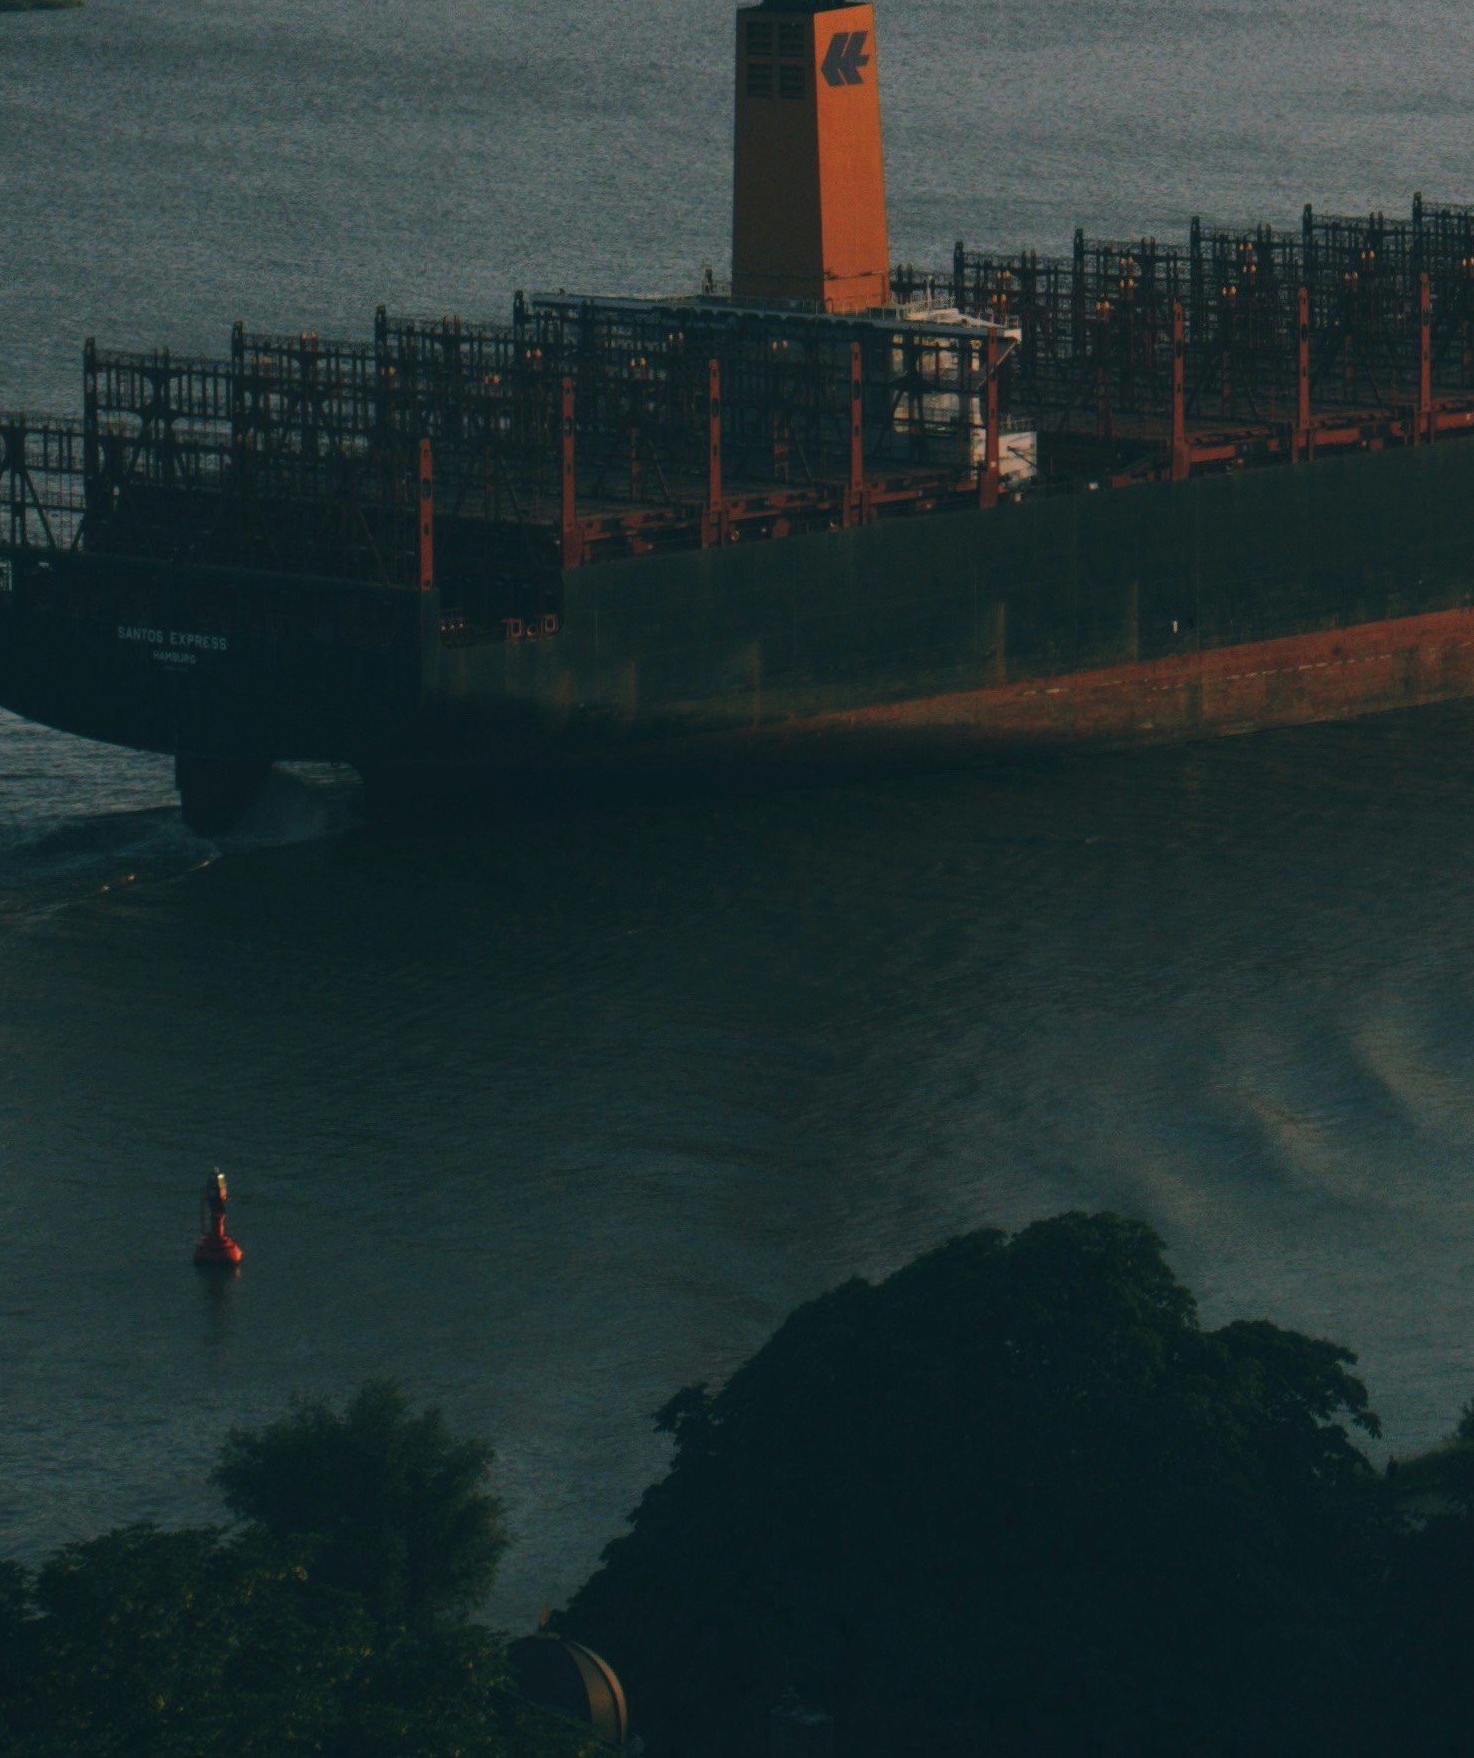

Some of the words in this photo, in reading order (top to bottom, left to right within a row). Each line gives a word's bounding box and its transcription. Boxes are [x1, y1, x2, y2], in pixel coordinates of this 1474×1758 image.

[117, 626, 164, 643] SANTOS
[170, 631, 228, 650] EXPRESS
[152, 650, 197, 664] HAMBURG
